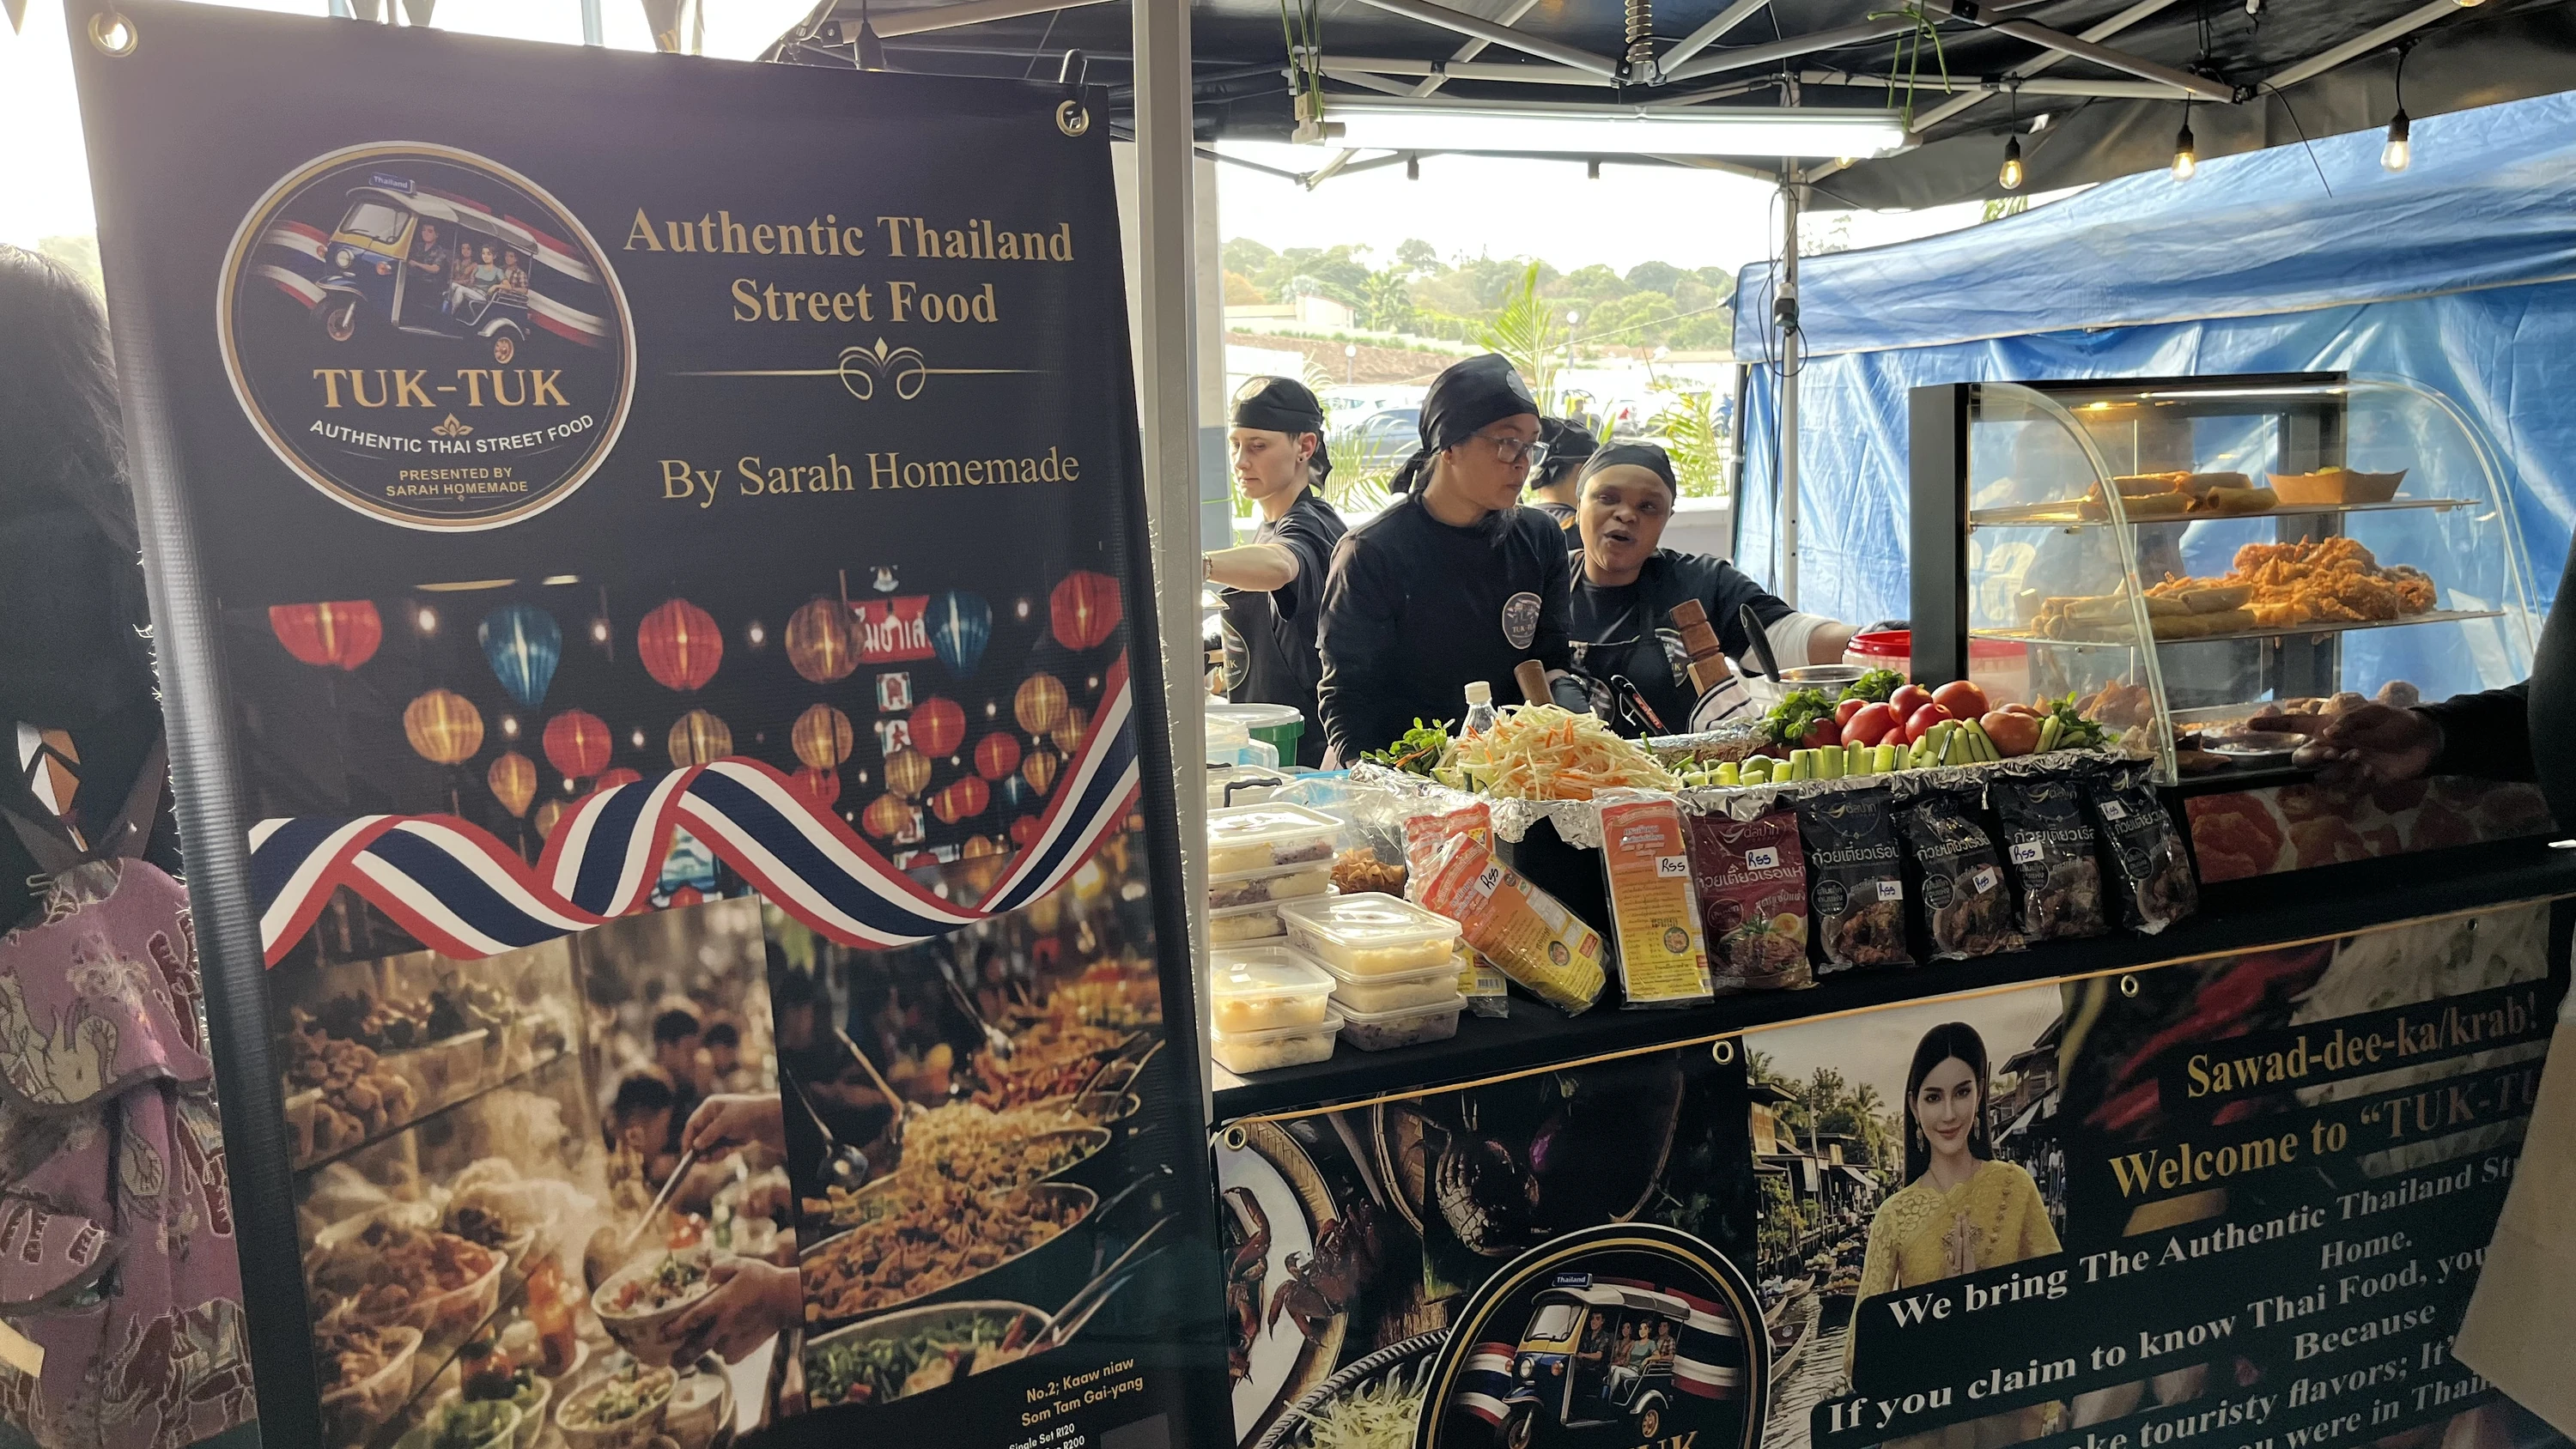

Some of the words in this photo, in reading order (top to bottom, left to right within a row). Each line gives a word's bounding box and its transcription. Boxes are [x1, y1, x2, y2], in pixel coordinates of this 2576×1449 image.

[373, 175, 409, 190] Thailand
[623, 207, 866, 257] Authentic
[877, 215, 1074, 261] Thailand
[732, 278, 874, 323] Street
[886, 281, 999, 324] Food
[313, 368, 570, 409] TUK-TUK
[309, 420, 422, 453] AUTHENTIC
[428, 439, 471, 454] THAI
[475, 431, 544, 453] STREET
[547, 414, 594, 438] FOOD
[386, 484, 440, 497] SARAH
[443, 481, 528, 495] HOMEMADE
[399, 468, 490, 481] PRESENTED
[493, 467, 513, 479] BY
[658, 458, 722, 508] By
[739, 453, 855, 496] Sarah
[866, 446, 1080, 490] Homemade
[2187, 991, 2537, 1099] Sawad-dee-ka/krab!
[2108, 1131, 2299, 1199] Welcome
[2311, 1125, 2348, 1156] to
[1887, 1292, 1951, 1328] We
[1965, 1270, 2068, 1312] bring
[2080, 1250, 2149, 1284] The
[2158, 1204, 2325, 1266] Authentic
[2336, 1164, 2472, 1222] Thailand
[2319, 1231, 2413, 1270] Home.
[1556, 1276, 1587, 1284] Thailand
[1826, 1397, 1868, 1434] If
[1876, 1386, 1952, 1428] you
[1967, 1357, 2075, 1400] claim
[2091, 1345, 2126, 1371] to
[2139, 1315, 2237, 1359] know
[2247, 1284, 2326, 1330] Thai
[2339, 1258, 2427, 1305] Food,
[2293, 1304, 2436, 1361] Because
[1063, 1369, 1100, 1391] Kaaw
[1103, 1357, 1134, 1376] niaw
[1021, 1409, 1051, 1427] Som
[1053, 1398, 1081, 1415] Tam
[1084, 1376, 1144, 1404] Gai-yang
[2139, 1393, 2278, 1448] touristy
[2288, 1355, 2409, 1409] flavors;
[2286, 1412, 2361, 1449] were
[2371, 1398, 2401, 1426] in
[1039, 1431, 1054, 1444] Set
[1055, 1422, 1075, 1439] R120
[1063, 1435, 1085, 1449] R200
